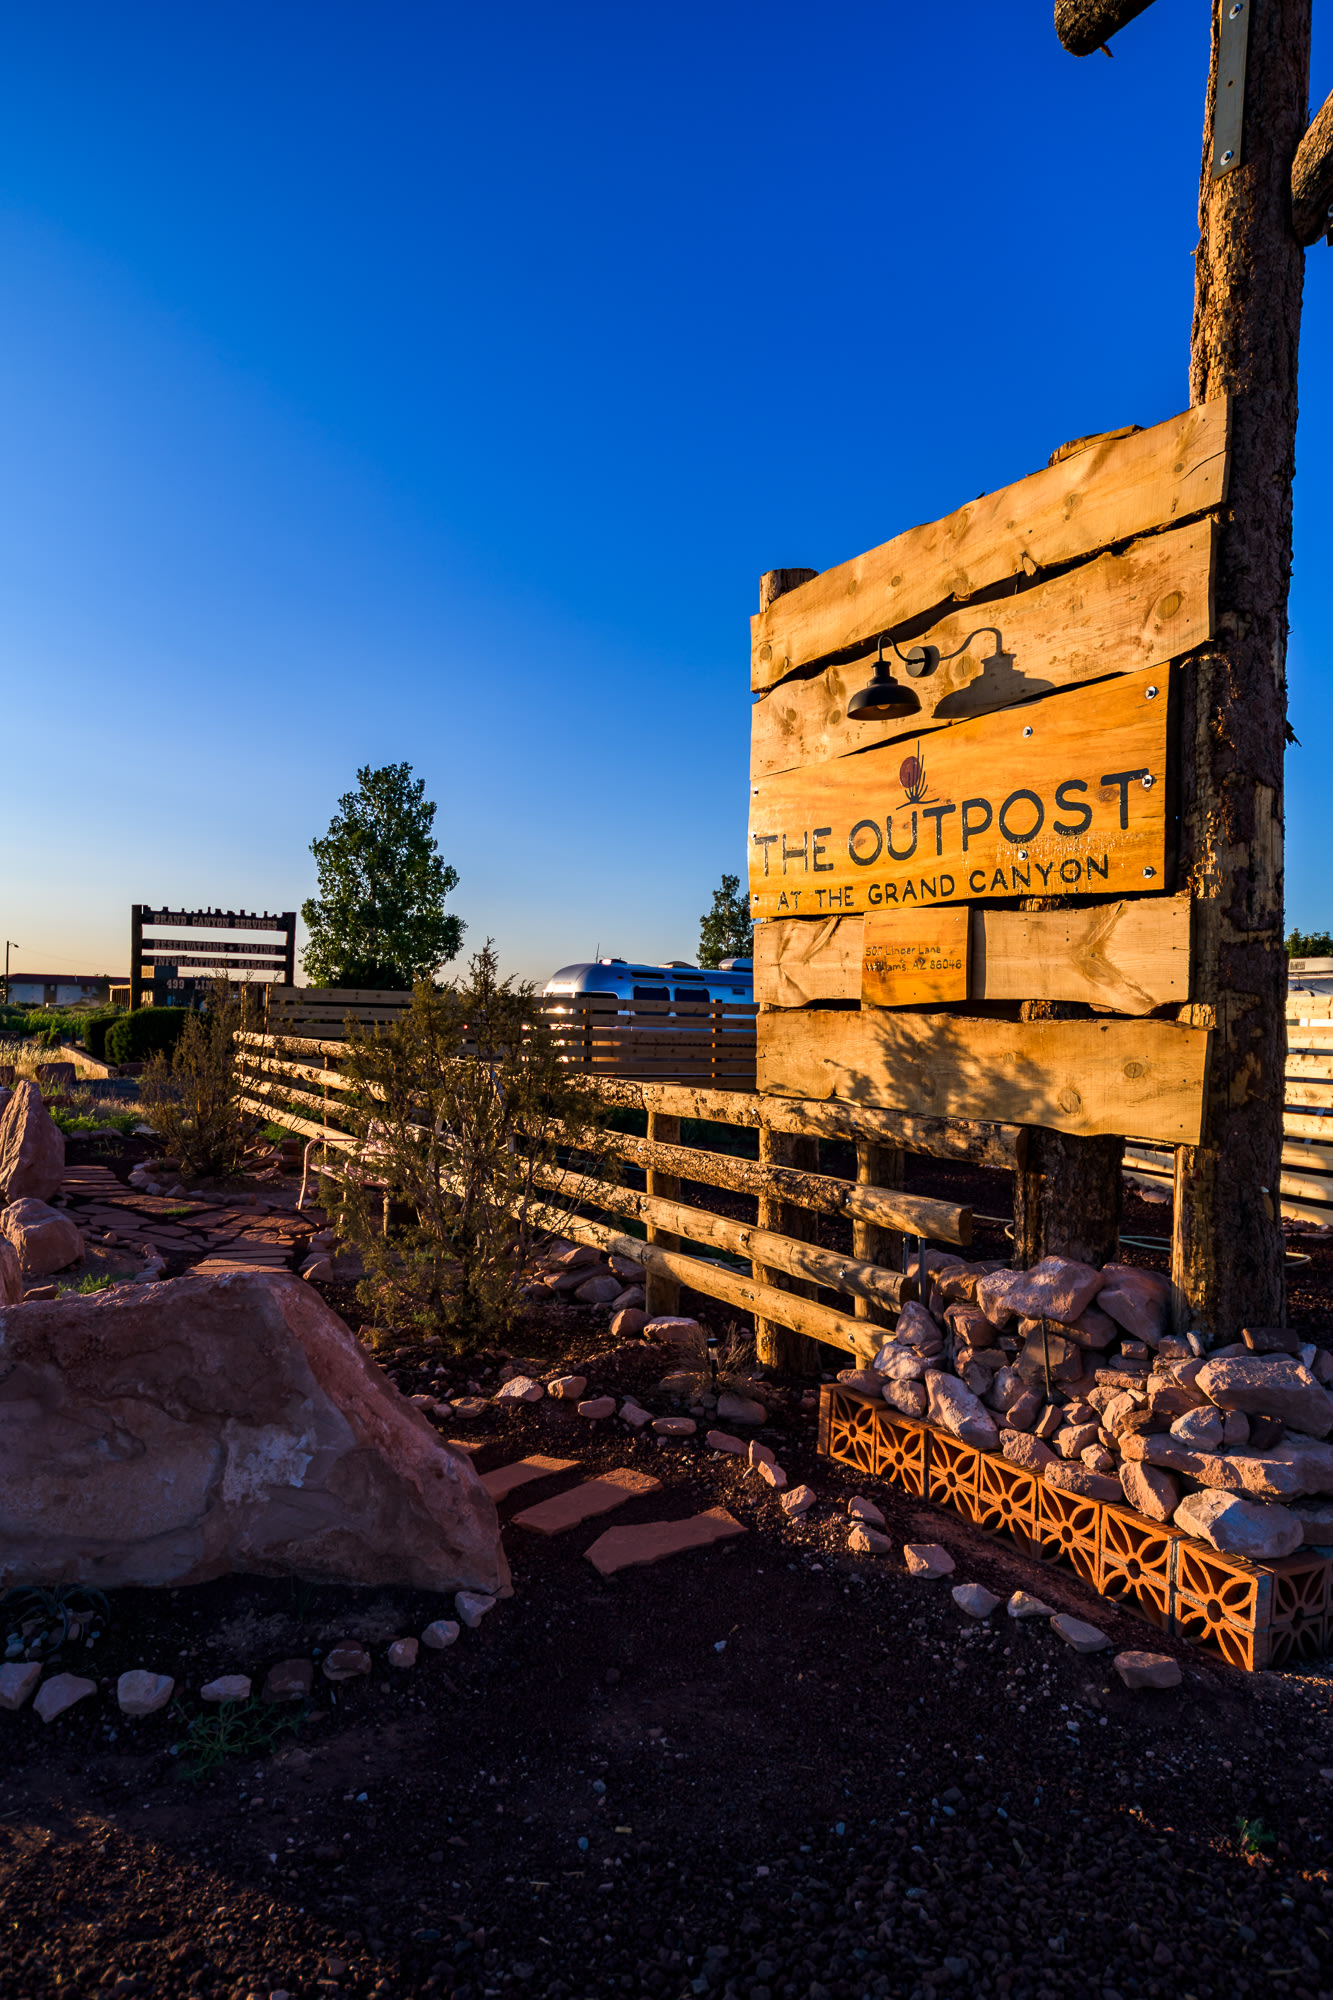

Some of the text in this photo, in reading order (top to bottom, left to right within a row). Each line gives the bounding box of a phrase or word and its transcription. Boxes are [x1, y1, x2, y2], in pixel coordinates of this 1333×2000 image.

[754, 768, 1150, 877] THE OUTPOST
[777, 853, 1109, 911] AT THE GRAND CANYON
[154, 913, 278, 930] GRAND CANYON SERVICES
[154, 940, 276, 954] RESERVATIONS TOWING
[865, 946, 883, 957] 507
[918, 944, 941, 955] Lane
[154, 957, 275, 970] INFORMATION GARAGE
[912, 959, 927, 970] AZ
[930, 958, 962, 970] 86046
[166, 978, 185, 990] 499
